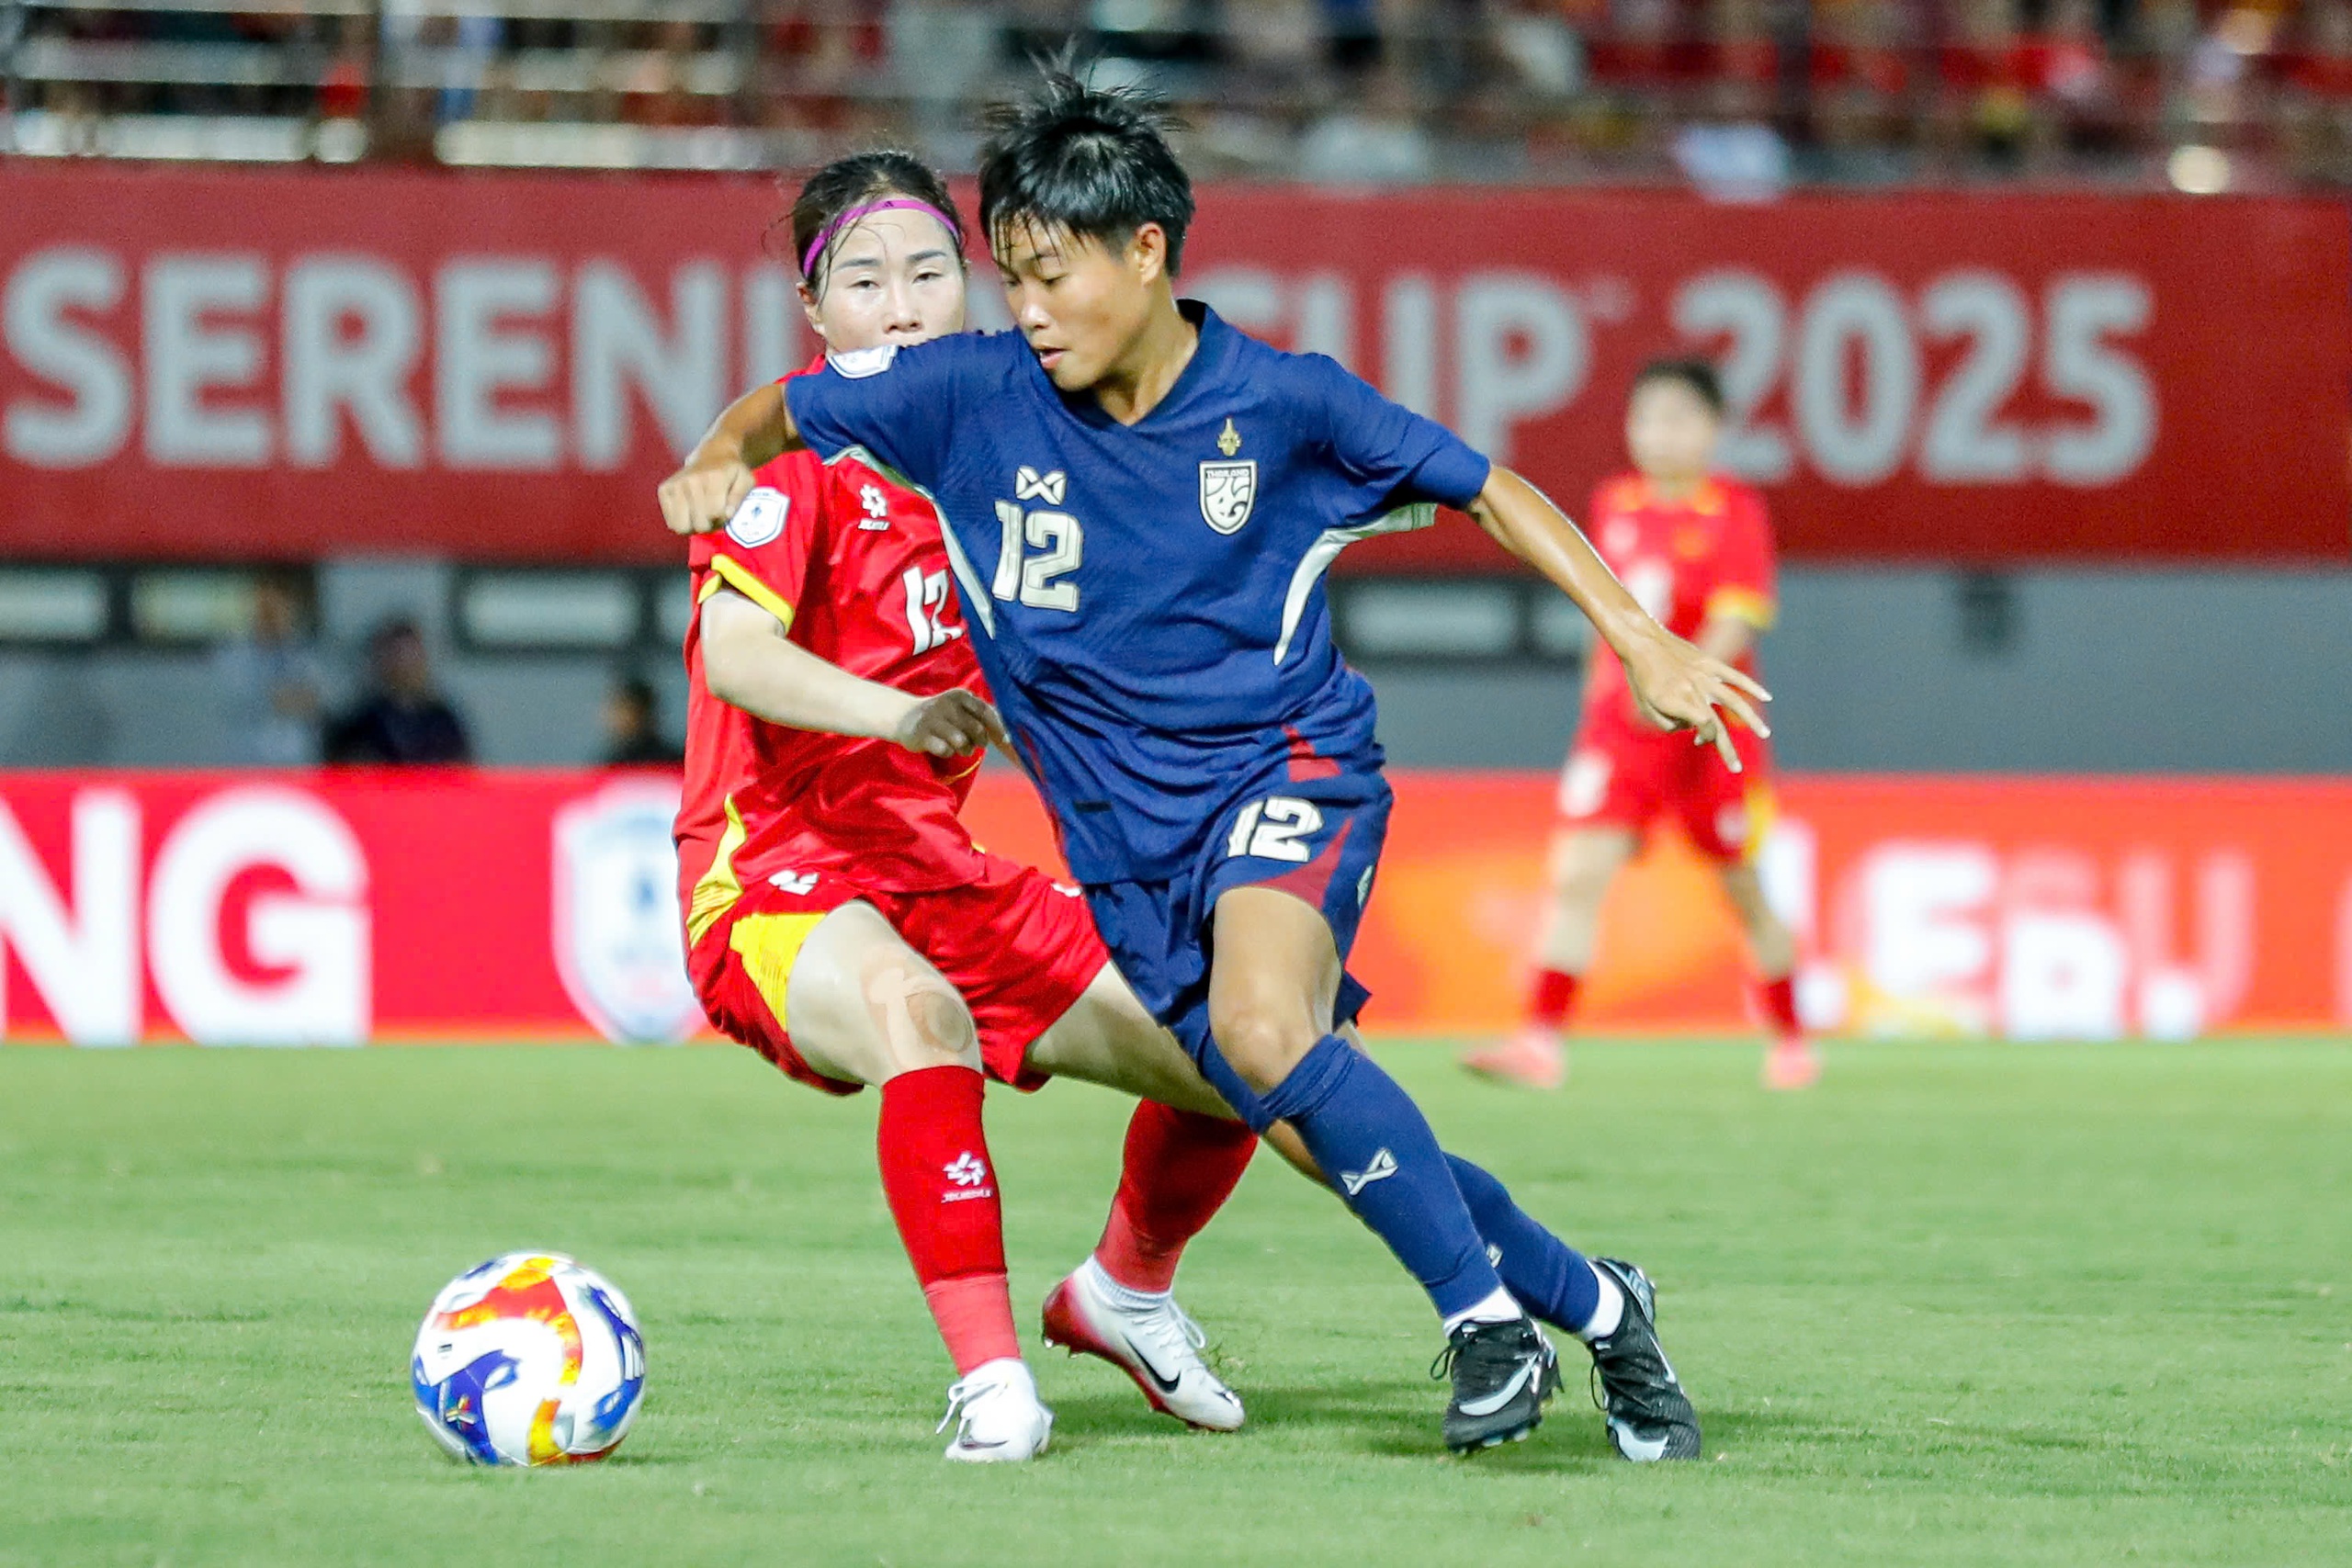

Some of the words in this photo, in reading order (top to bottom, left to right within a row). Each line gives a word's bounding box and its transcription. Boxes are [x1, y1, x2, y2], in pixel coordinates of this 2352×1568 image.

[3, 243, 1014, 472] SERENI
[1670, 269, 2161, 487] 2025
[992, 500, 1084, 613] 12
[902, 565, 965, 657] 12
[1227, 795, 1325, 863] 12
